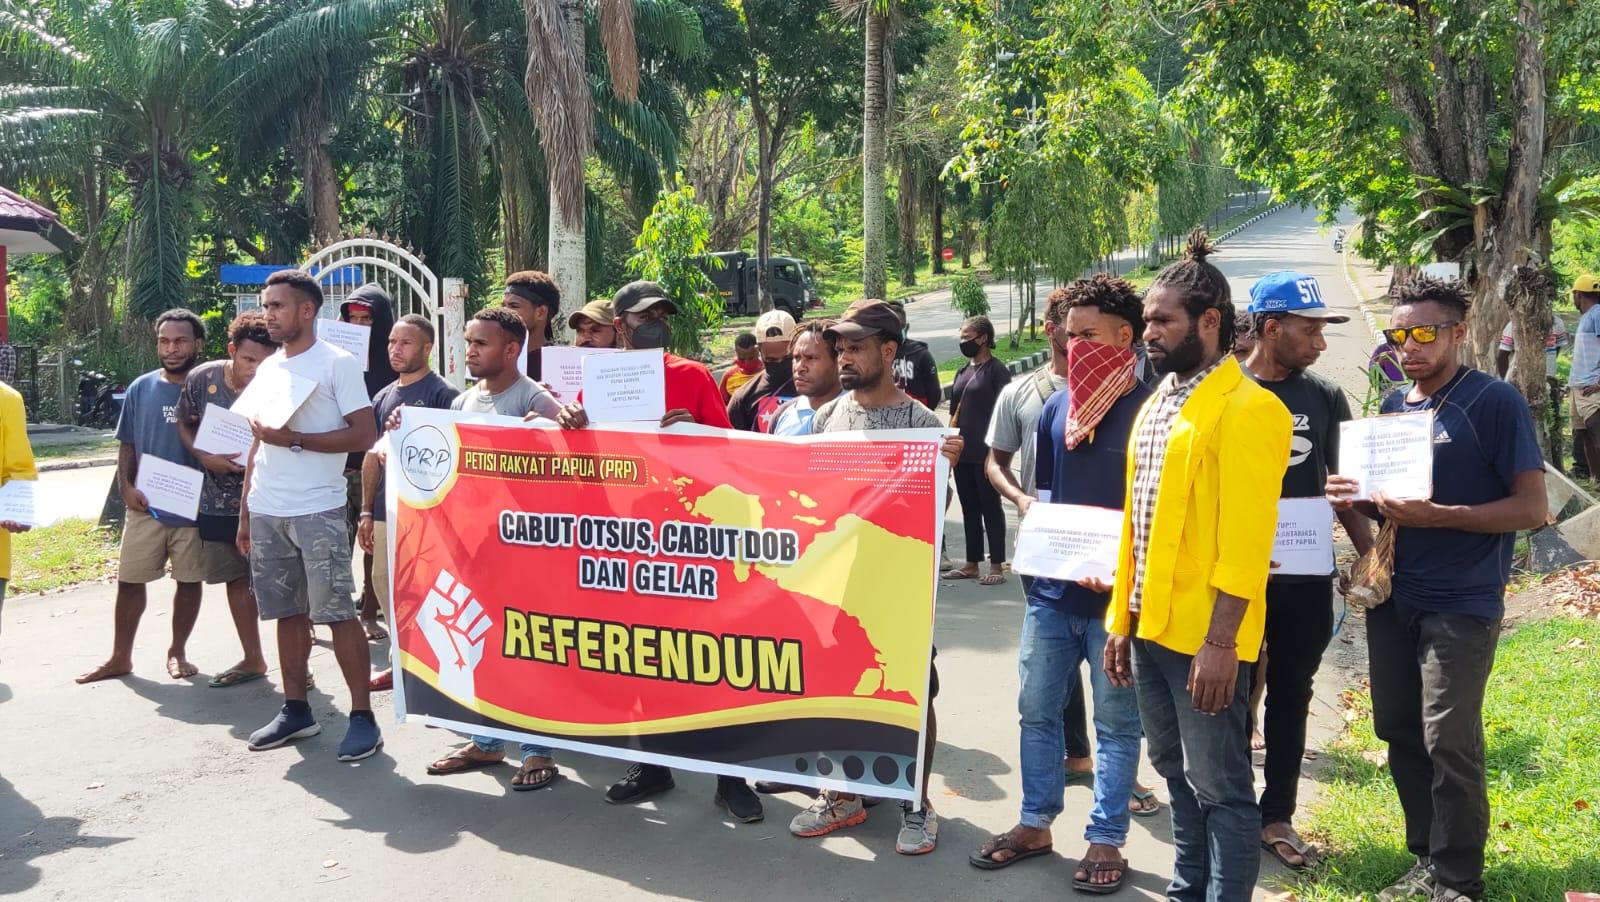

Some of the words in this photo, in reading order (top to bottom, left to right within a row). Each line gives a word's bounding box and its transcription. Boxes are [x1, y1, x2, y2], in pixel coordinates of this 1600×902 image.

[405, 445, 450, 468] PRP
[465, 450, 497, 472] PETISI
[499, 454, 547, 475] RAKYAT
[551, 457, 596, 478] PAPUA
[599, 459, 638, 482] (PRP)
[500, 512, 575, 545] CABUT
[578, 517, 657, 555] OTSUS,
[662, 523, 739, 558] CABUT
[744, 528, 798, 562] DOB
[581, 557, 628, 590] DAN
[634, 562, 716, 598] GELAR
[503, 608, 803, 693] REFERENDUM
